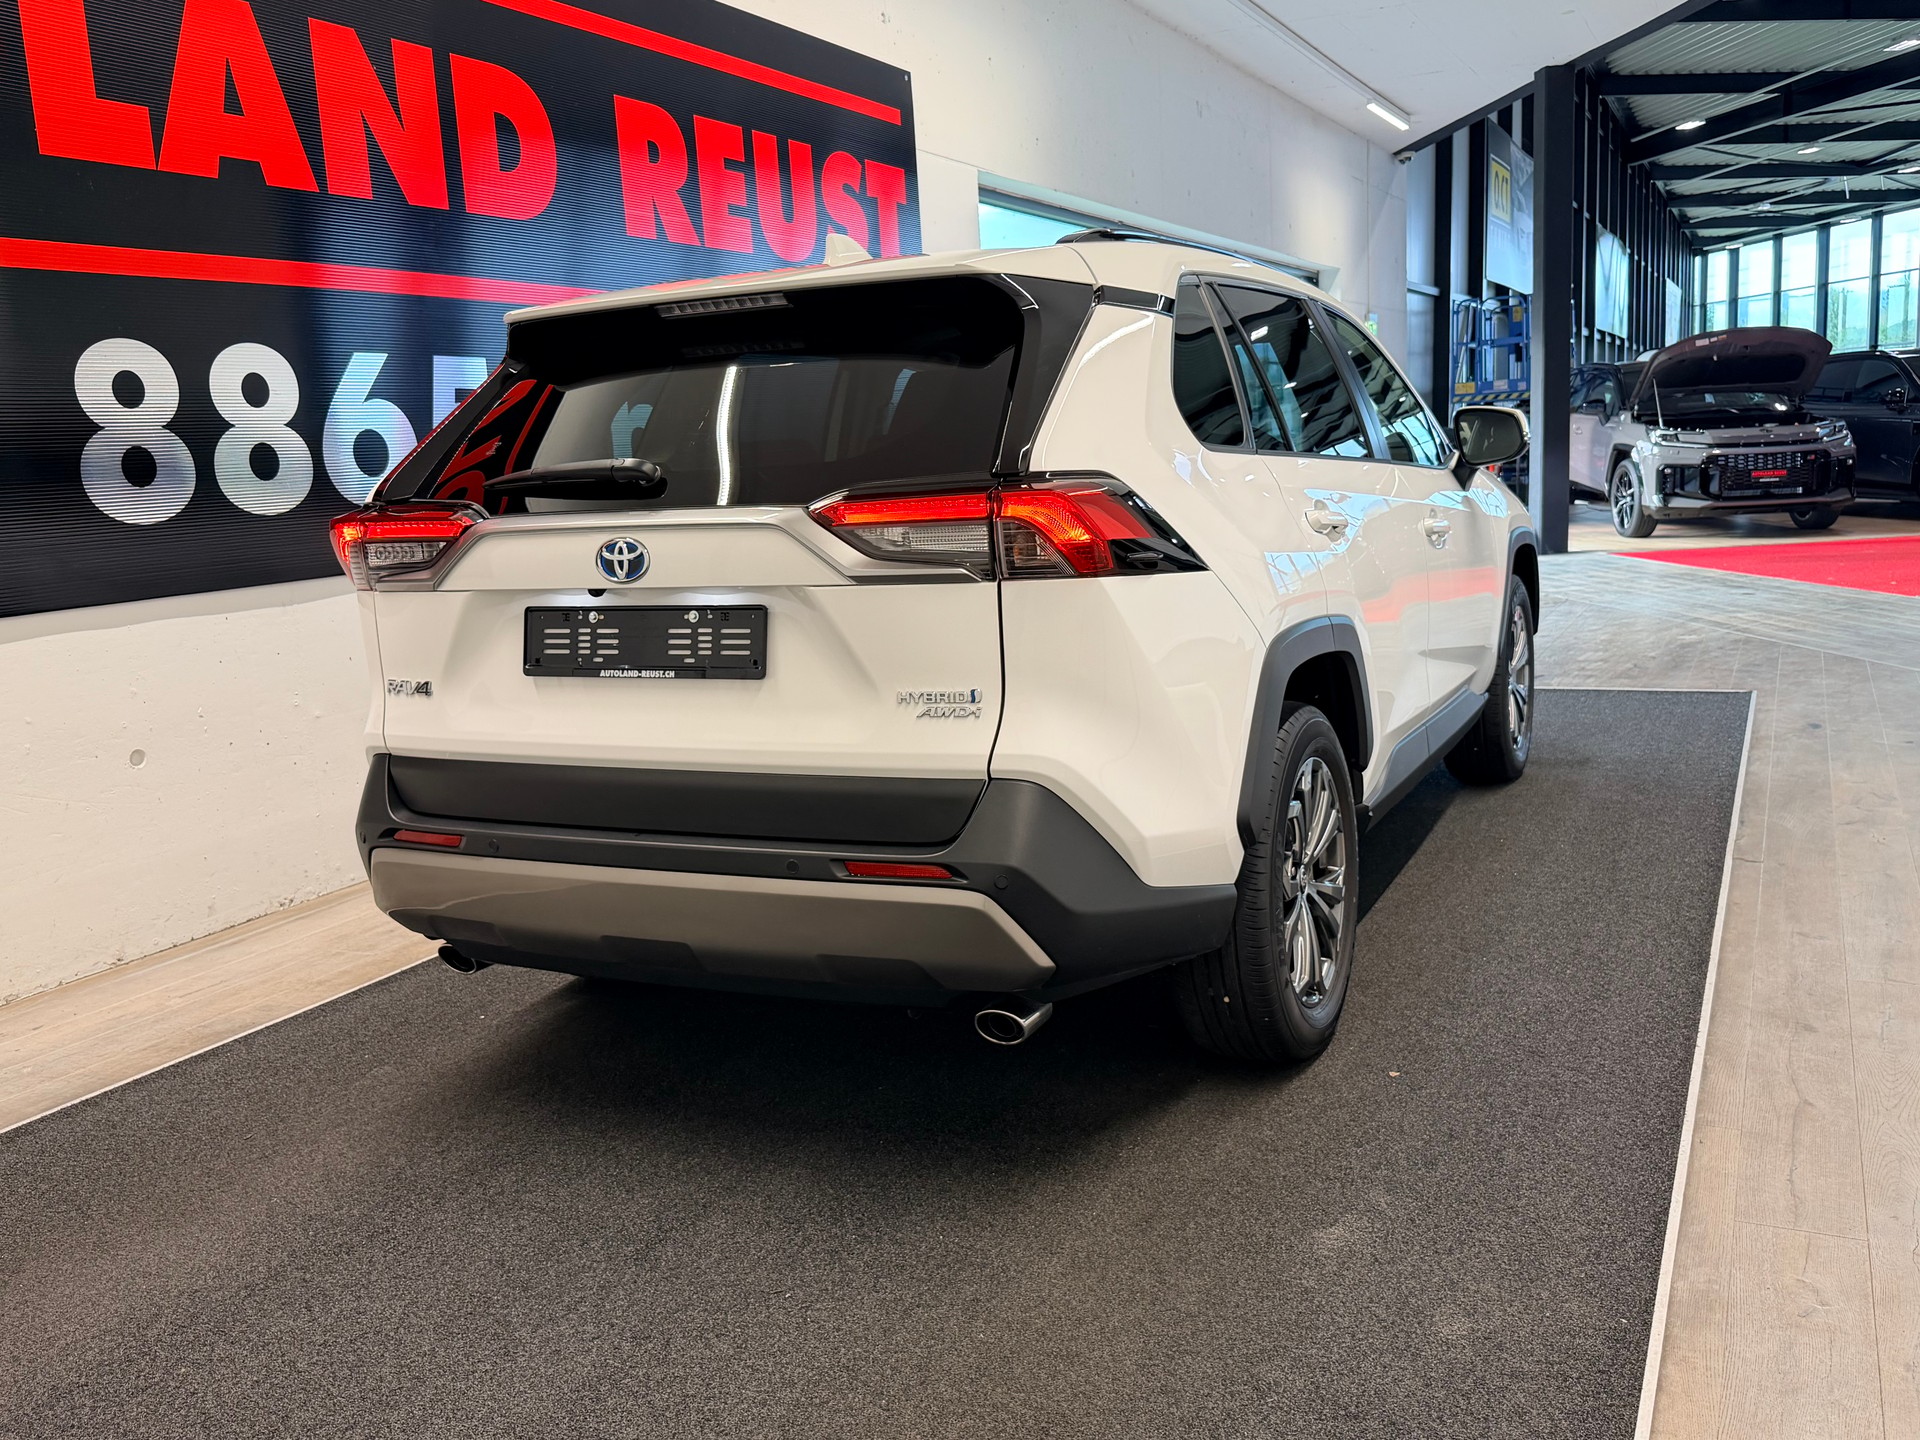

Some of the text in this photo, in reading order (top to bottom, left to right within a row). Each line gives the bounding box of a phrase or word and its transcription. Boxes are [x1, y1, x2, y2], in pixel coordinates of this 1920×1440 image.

[18, 0, 907, 262] LAND REUST
[599, 669, 675, 678] AUTOLAND-REUST.CH
[387, 679, 433, 696] RAV4
[897, 690, 969, 704] HYBRID
